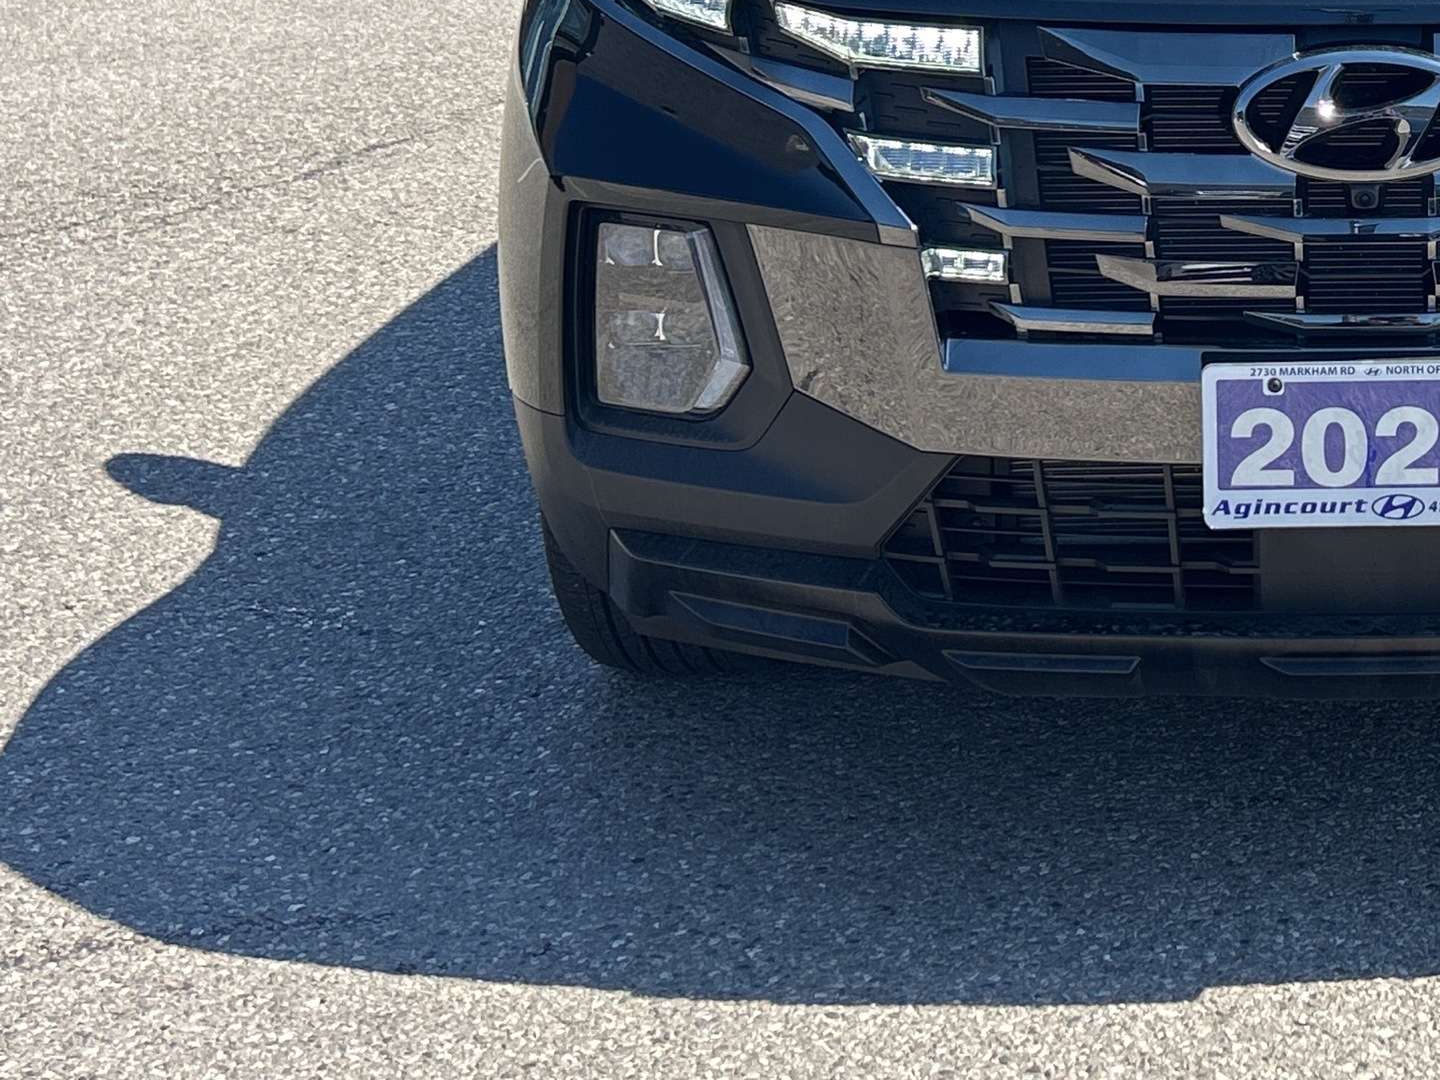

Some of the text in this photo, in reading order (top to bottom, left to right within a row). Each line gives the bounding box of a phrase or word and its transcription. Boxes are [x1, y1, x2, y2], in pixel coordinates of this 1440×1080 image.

[1250, 367, 1277, 377] 2730
[1278, 366, 1338, 377] MARKHAM
[1339, 366, 1356, 376] RD
[1385, 365, 1425, 376] NORTH
[1211, 498, 1368, 519] Agincourt
